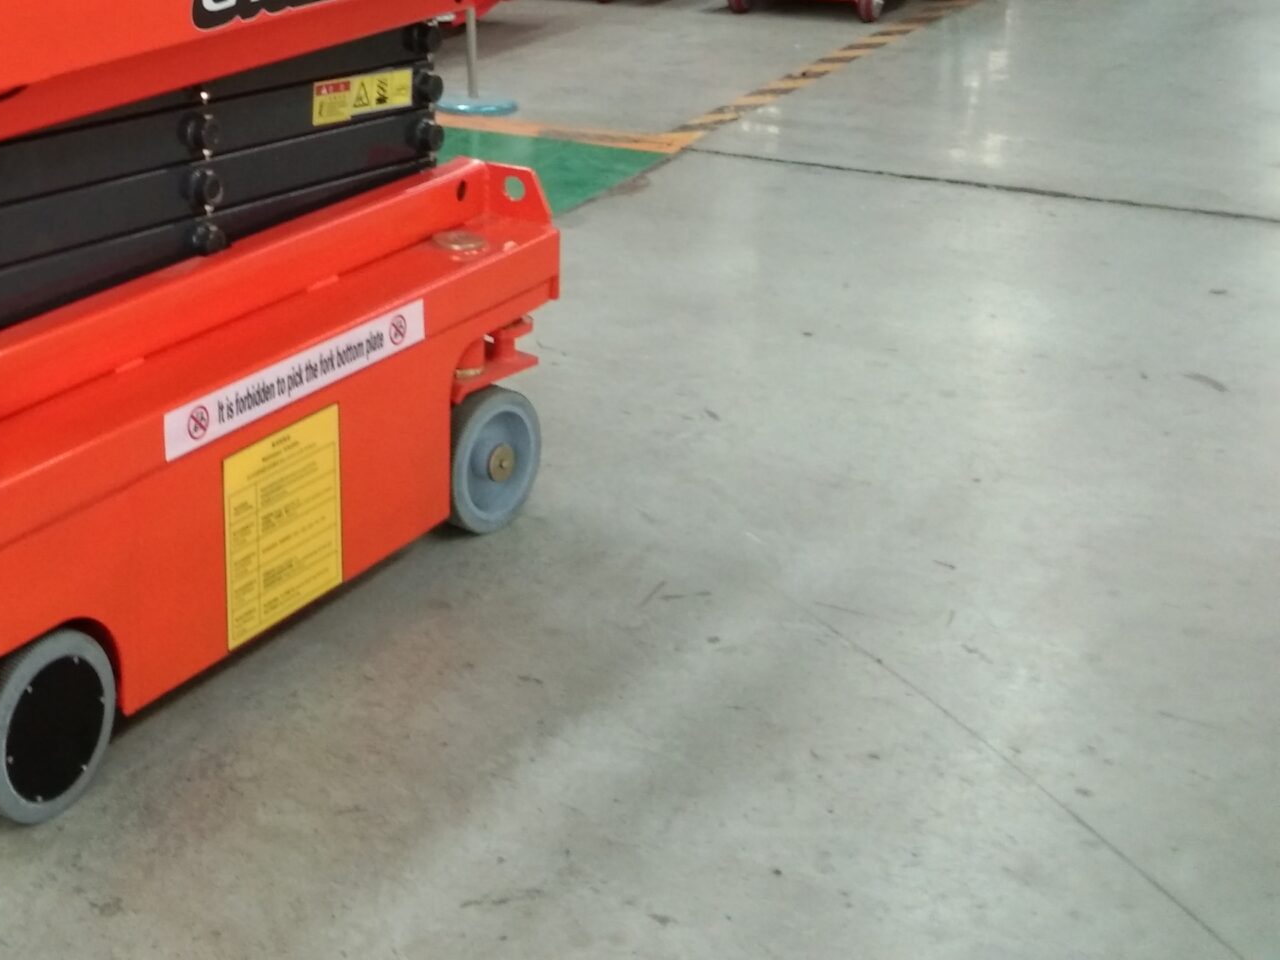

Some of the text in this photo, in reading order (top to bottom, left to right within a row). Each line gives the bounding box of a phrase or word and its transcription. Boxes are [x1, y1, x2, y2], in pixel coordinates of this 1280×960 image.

[217, 331, 384, 424] It is forbidden to pick the fork bottom plate
